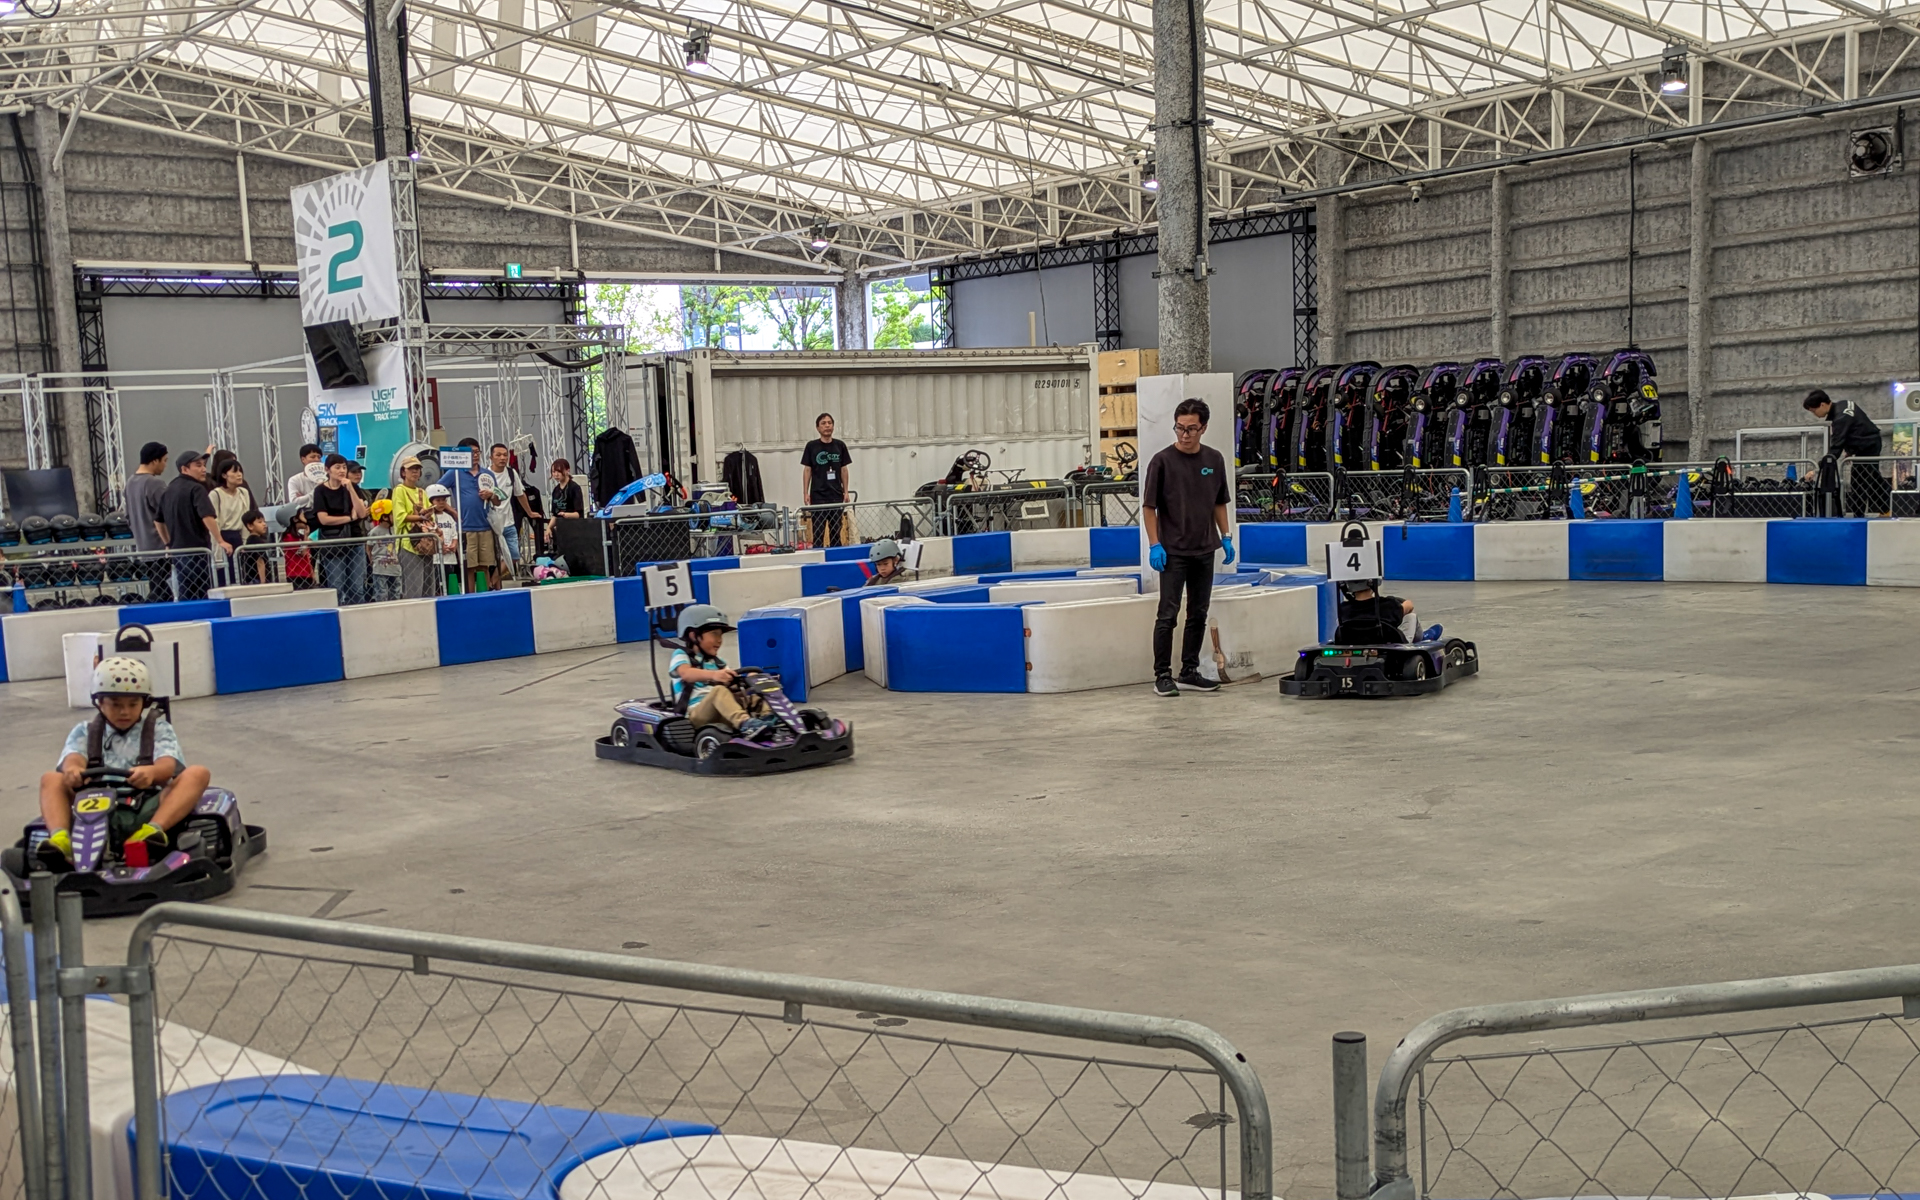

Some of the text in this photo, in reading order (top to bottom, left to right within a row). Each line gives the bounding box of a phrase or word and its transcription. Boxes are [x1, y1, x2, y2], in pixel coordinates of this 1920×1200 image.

[328, 220, 364, 295] 2
[371, 387, 397, 401] LIGHT
[318, 403, 337, 416] SKY
[319, 418, 339, 426] TRACK
[374, 413, 390, 421] TRACK
[1346, 552, 1362, 572] 4
[665, 575, 679, 597] 5
[1341, 677, 1354, 688] 15
